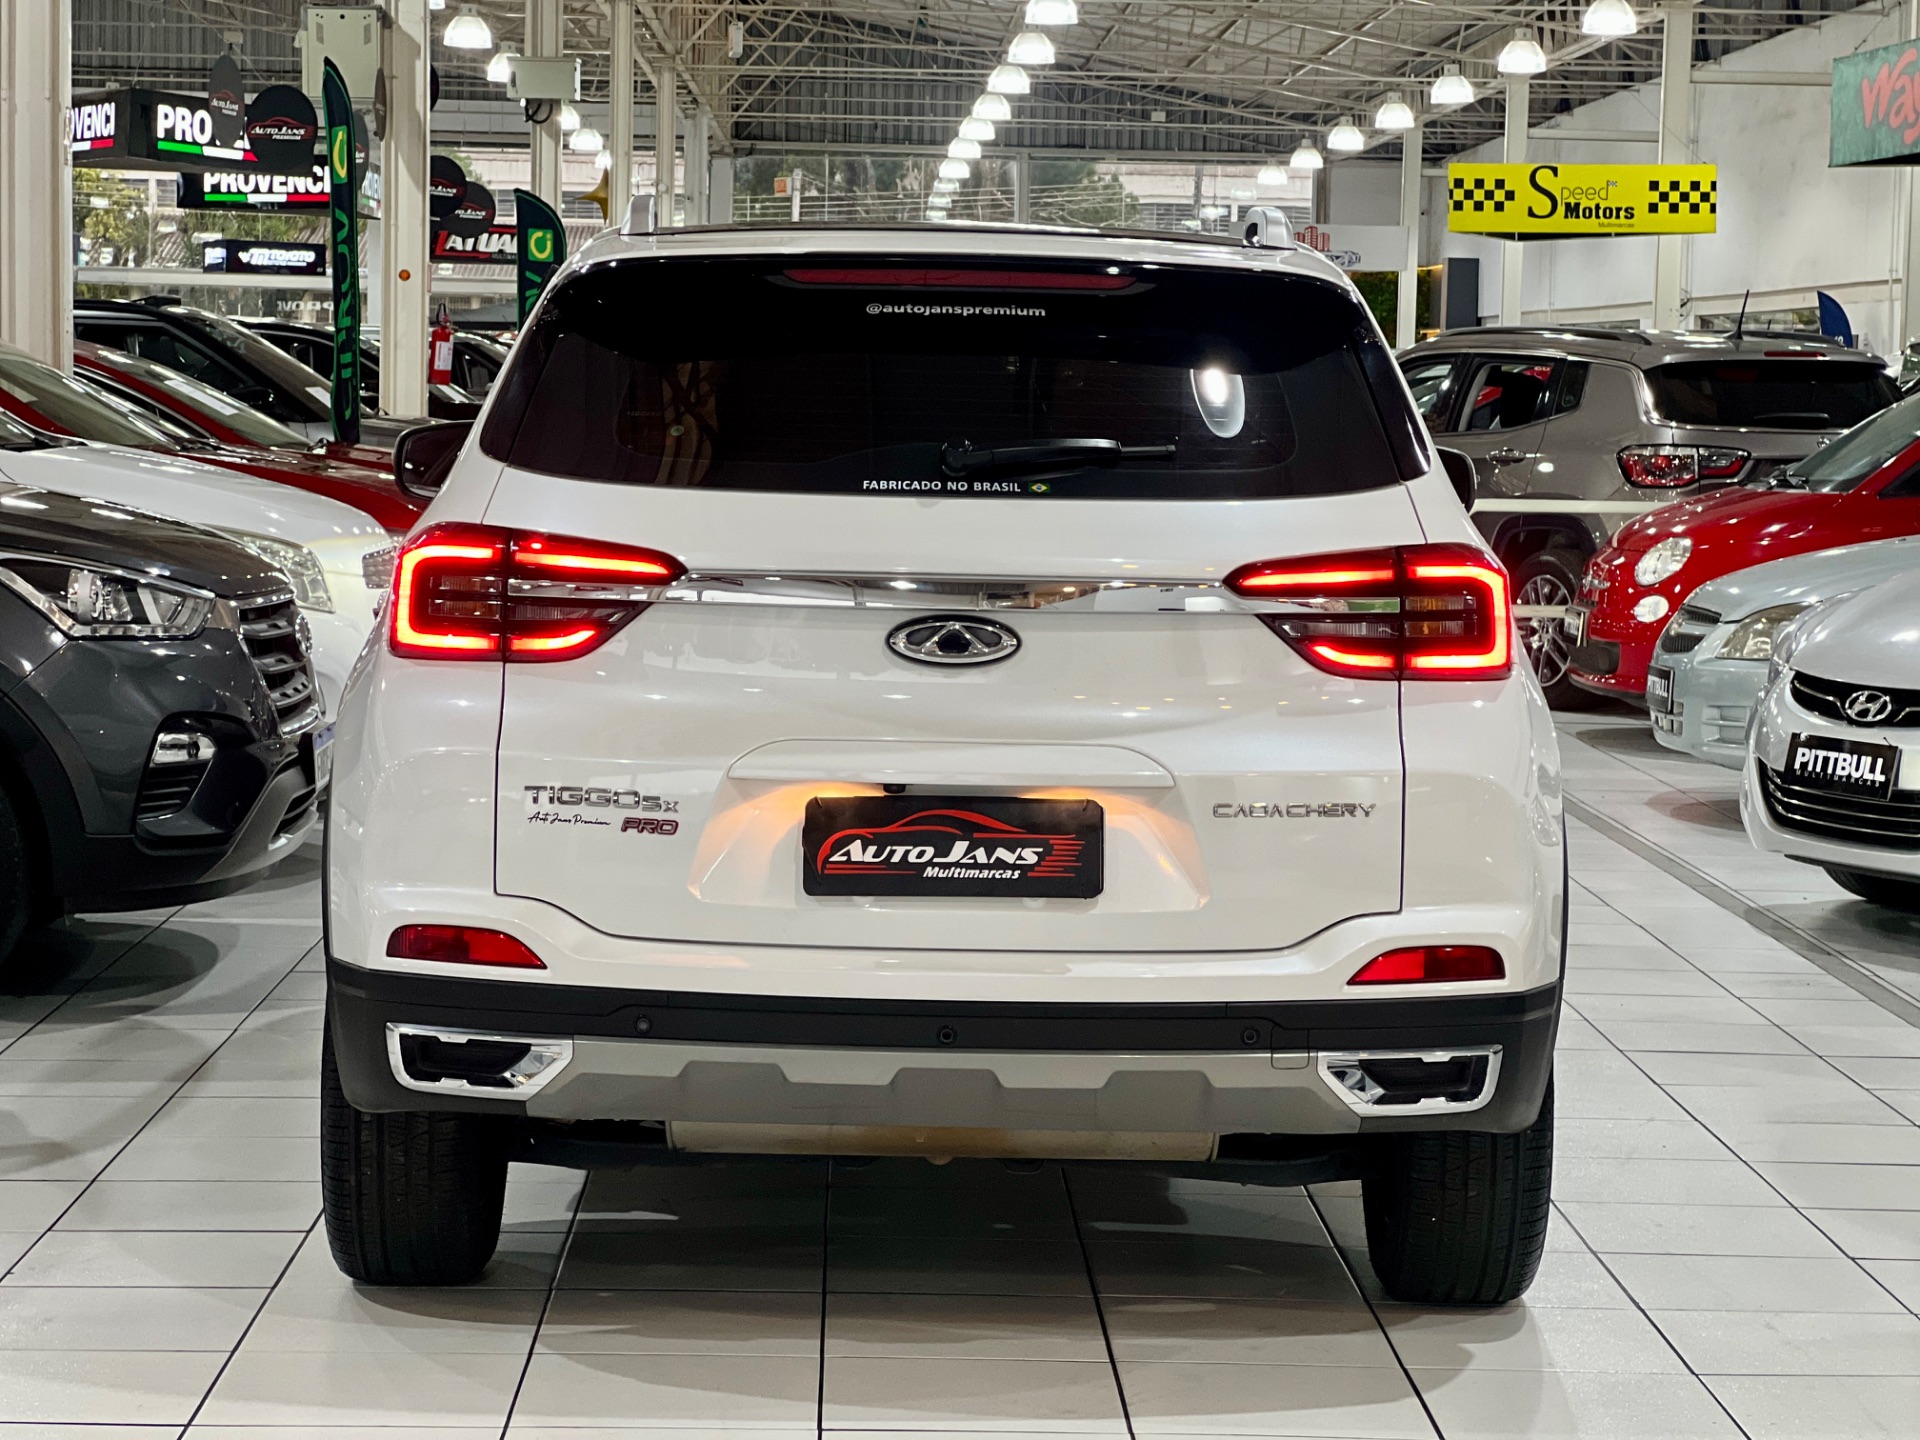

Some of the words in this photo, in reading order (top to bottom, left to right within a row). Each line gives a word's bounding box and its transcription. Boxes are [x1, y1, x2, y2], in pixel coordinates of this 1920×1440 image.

[1527, 165, 1609, 220] Speed
[1563, 202, 1635, 220] Motors
[866, 303, 1046, 316] @autojanspremium
[863, 480, 942, 490] FABRICADO
[947, 481, 968, 491] NO
[973, 482, 1021, 492] BRASIL
[1793, 747, 1886, 782] PITTBULL
[1795, 768, 1880, 787] MULTIMARCAS
[620, 817, 679, 836] PRO
[828, 839, 931, 863] AUTO
[932, 840, 1043, 865] JANS
[922, 866, 1021, 879] Multimarcas
